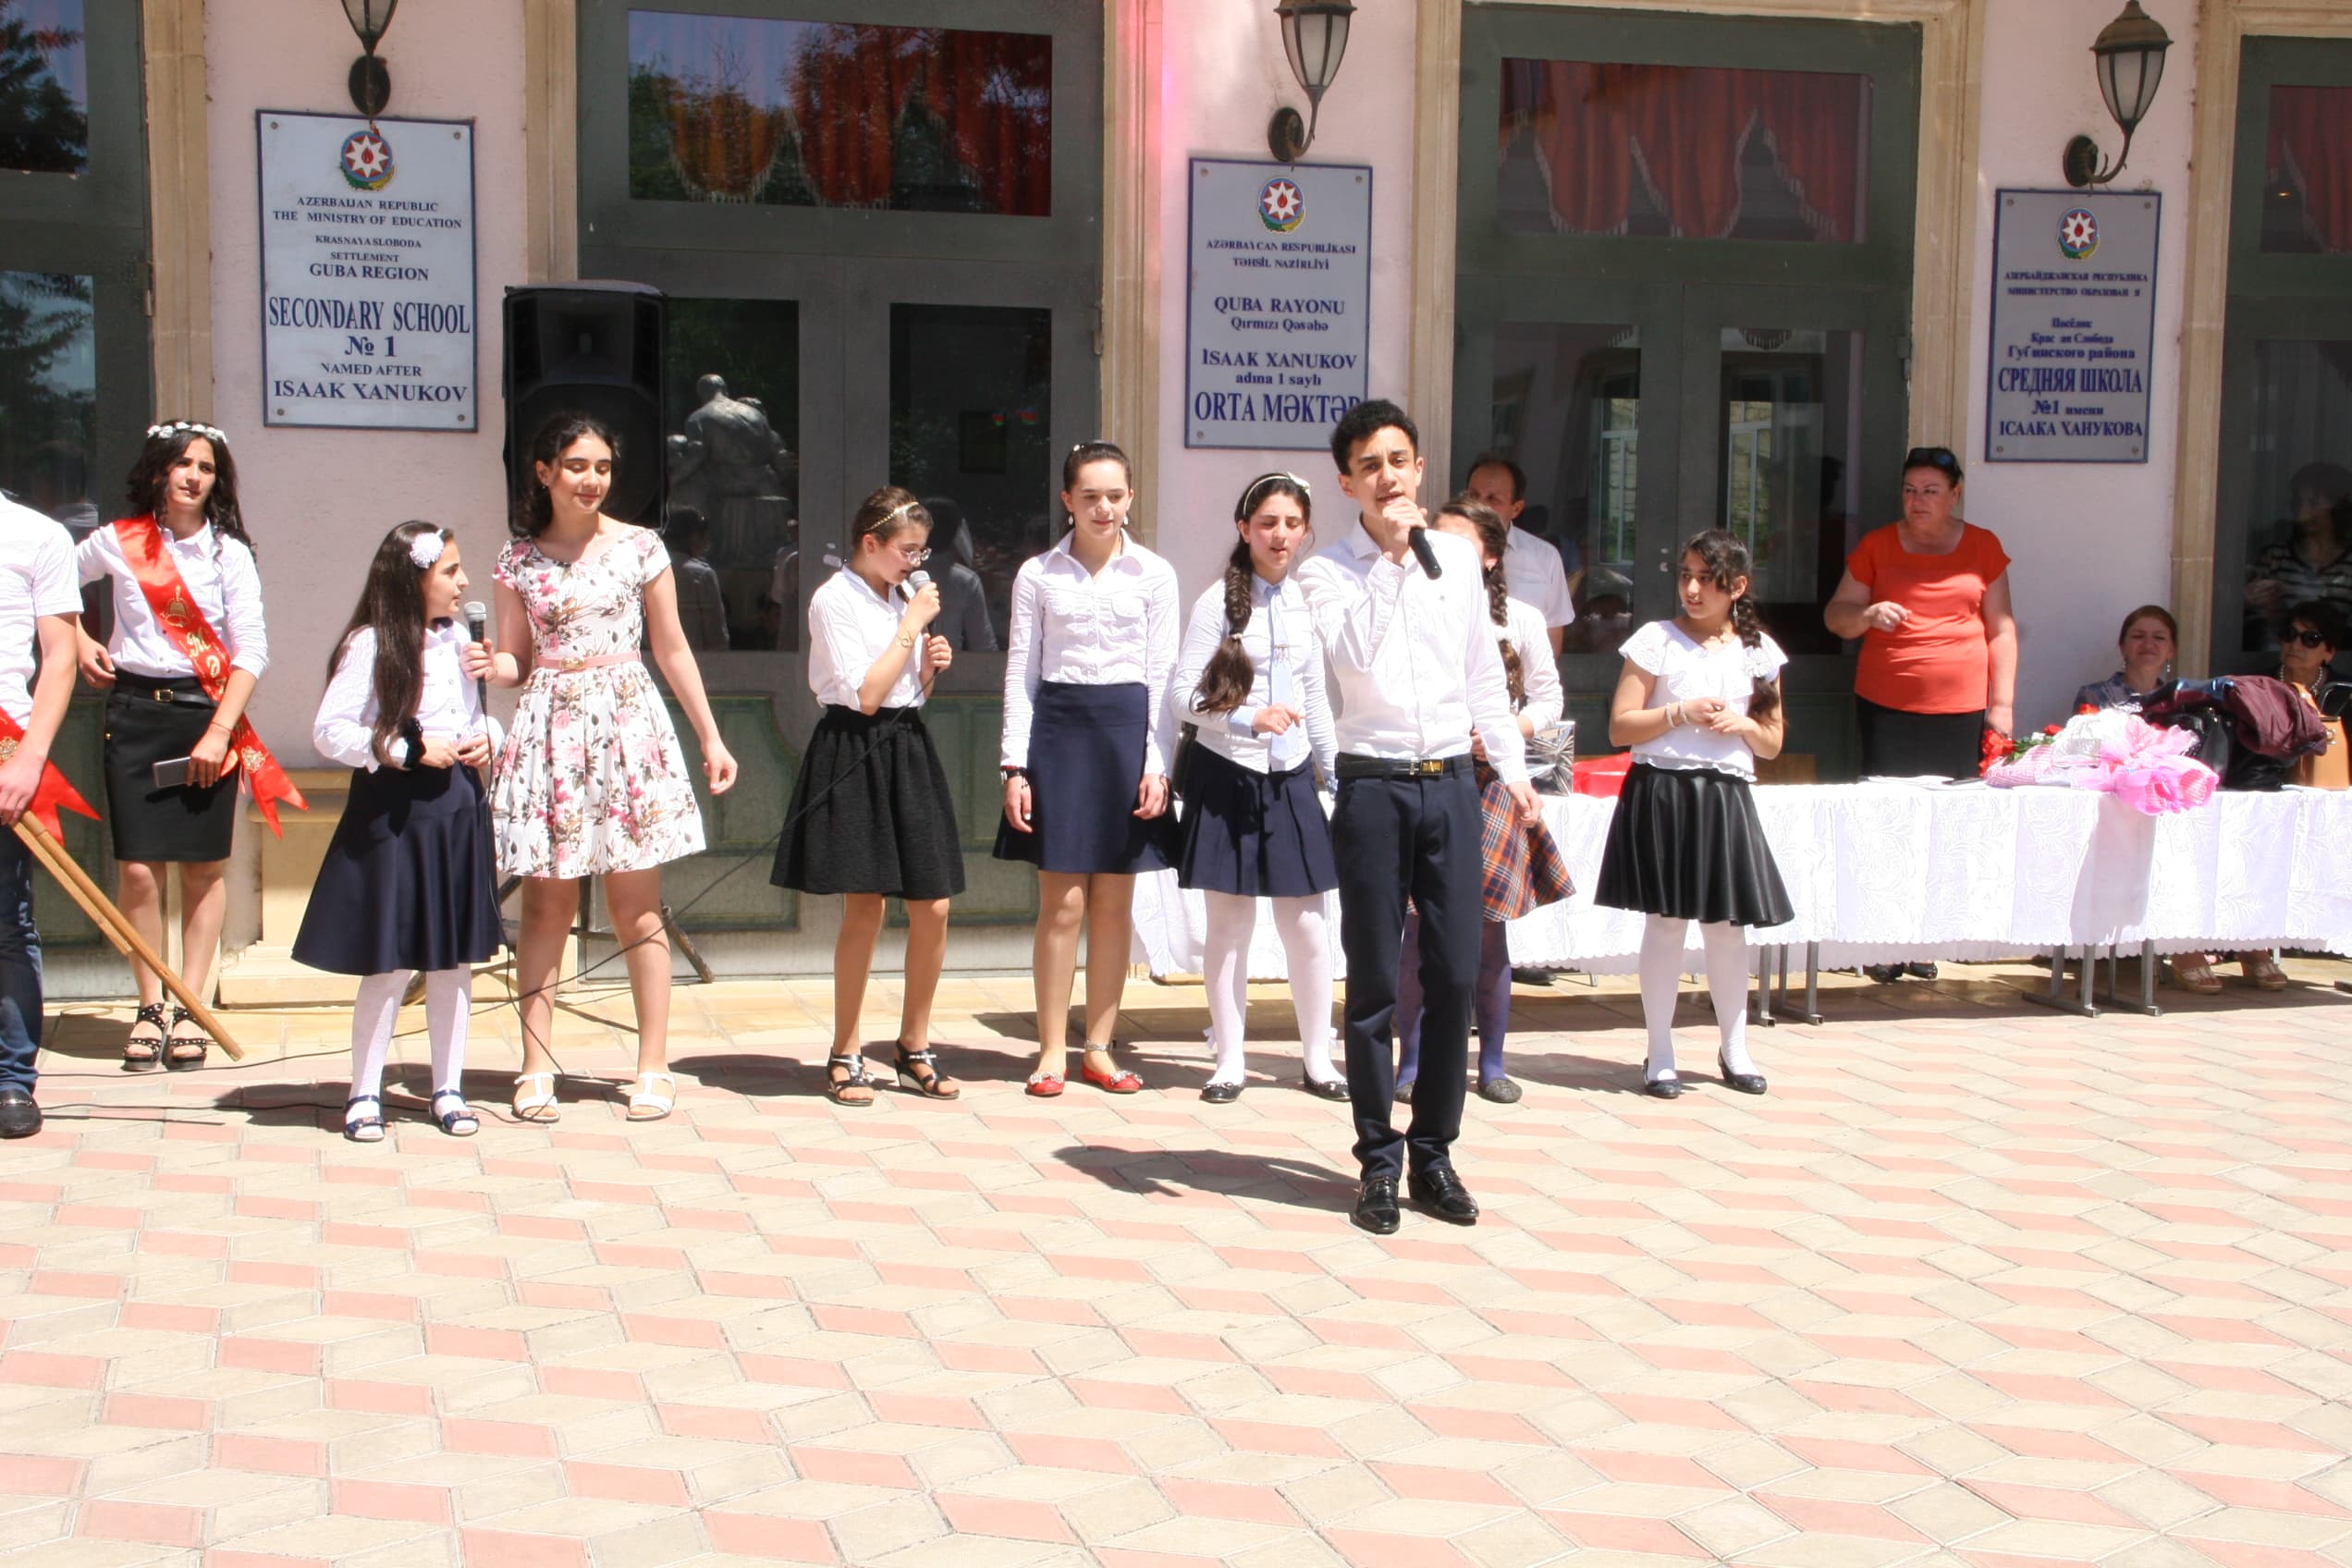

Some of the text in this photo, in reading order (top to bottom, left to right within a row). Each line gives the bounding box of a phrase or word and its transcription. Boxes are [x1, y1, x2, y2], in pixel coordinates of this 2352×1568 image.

[297, 196, 438, 212] AZERBAIJAN REPUBLIC
[274, 211, 461, 228] THE MINISTRY OF EDUCATION
[315, 235, 422, 248] KRASNAYA SLOBODA
[330, 251, 399, 263] SETTLEMENT
[310, 263, 429, 280] GUBA REGION
[1214, 297, 1344, 314] QUBA RAYONU
[269, 296, 471, 333] SECONDARY SCHOOL
[1282, 319, 1329, 332] Qəsəbə
[385, 336, 398, 357] 1
[321, 362, 422, 376] NAMED AFTER
[1266, 351, 1357, 370] XANUKOV
[1279, 373, 1284, 385] 1
[1998, 367, 2142, 396] СРЕДНЯЯ ШКОЛА
[275, 380, 468, 402] ISAAK XANUKOV
[1194, 391, 1256, 422] ORTA
[2061, 422, 2143, 436] ХАНУКОВА
